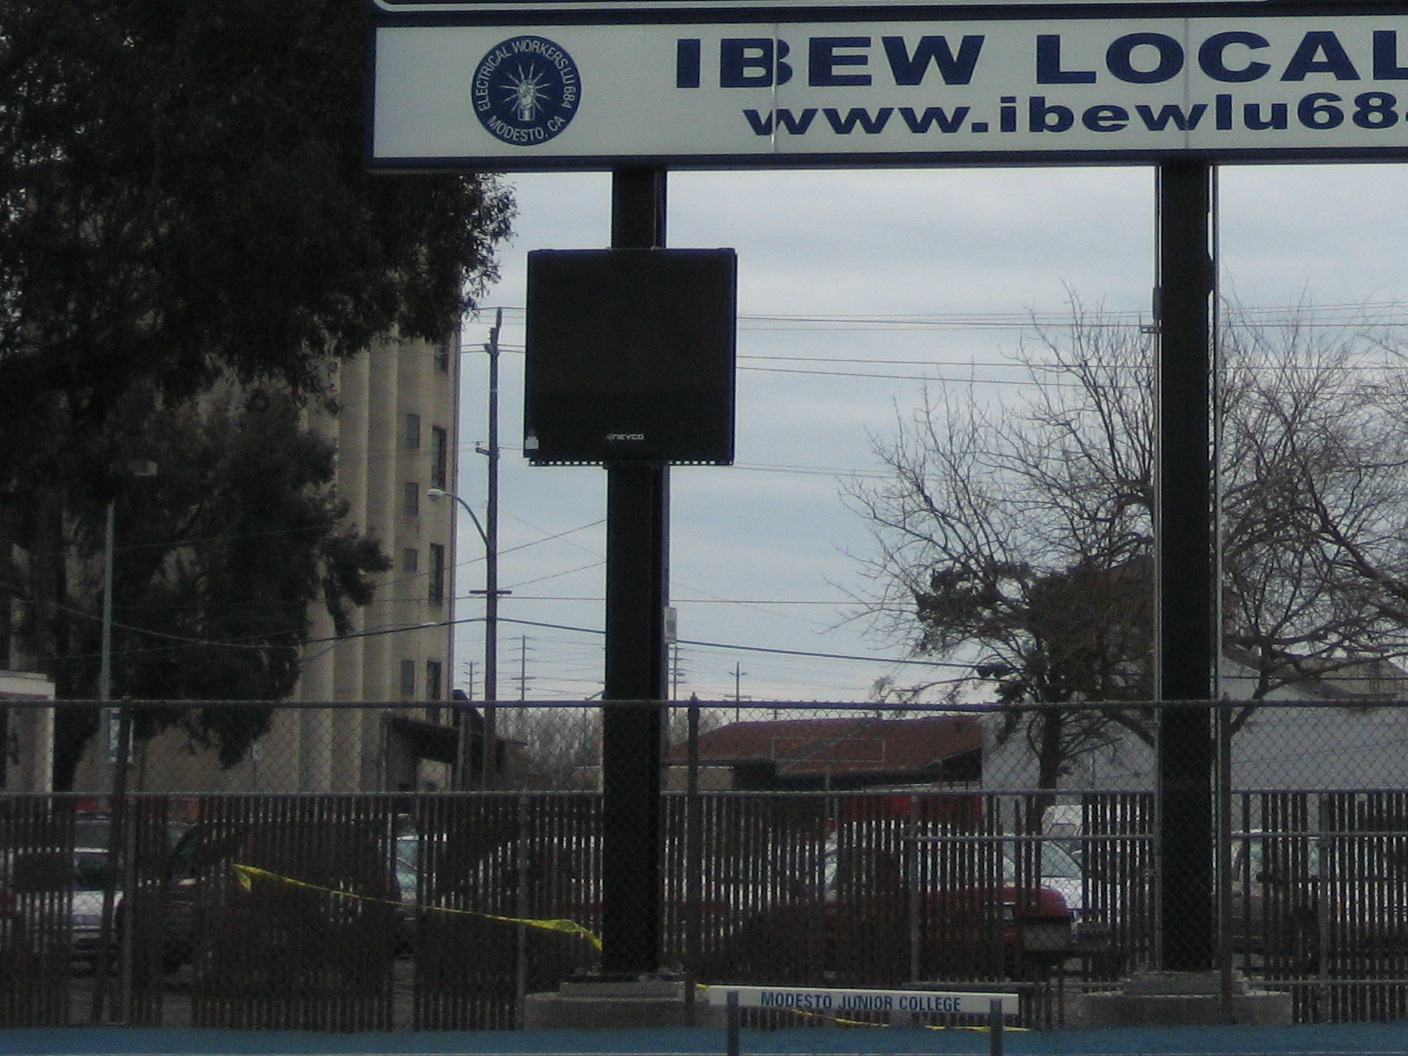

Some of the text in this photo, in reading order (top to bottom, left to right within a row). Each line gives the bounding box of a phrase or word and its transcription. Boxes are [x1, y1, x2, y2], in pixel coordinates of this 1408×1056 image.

[475, 45, 513, 112] ELECTRICAL
[510, 38, 569, 70] WORKERS
[676, 34, 986, 88] IBEW
[547, 114, 566, 132] CA
[761, 991, 962, 1013] MODESTO JUNIOR COLLEGE
